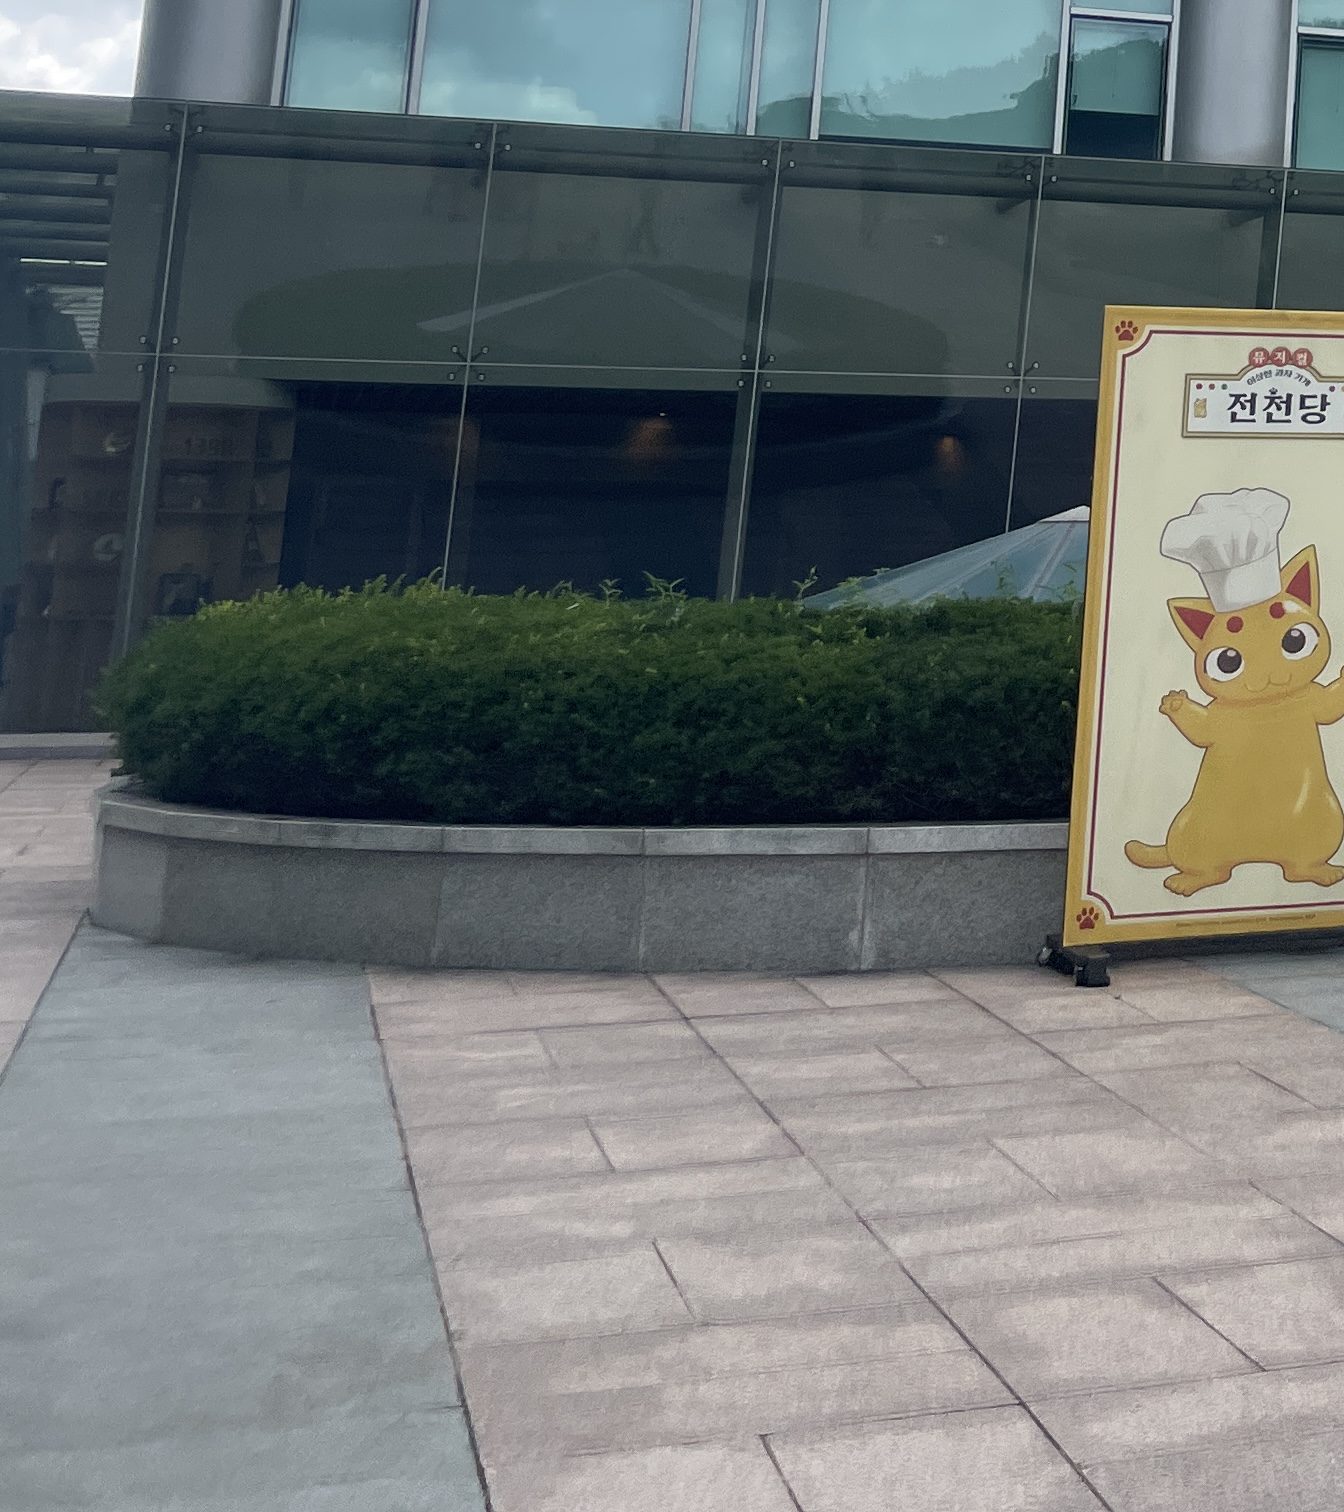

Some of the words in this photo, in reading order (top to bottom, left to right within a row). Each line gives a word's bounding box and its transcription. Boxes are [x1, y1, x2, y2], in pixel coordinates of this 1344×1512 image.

[1252, 350, 1309, 366] 뮤지컬
[1275, 369, 1293, 378] 과자
[1294, 373, 1312, 387] 가게
[1227, 392, 1331, 424] 전천당
